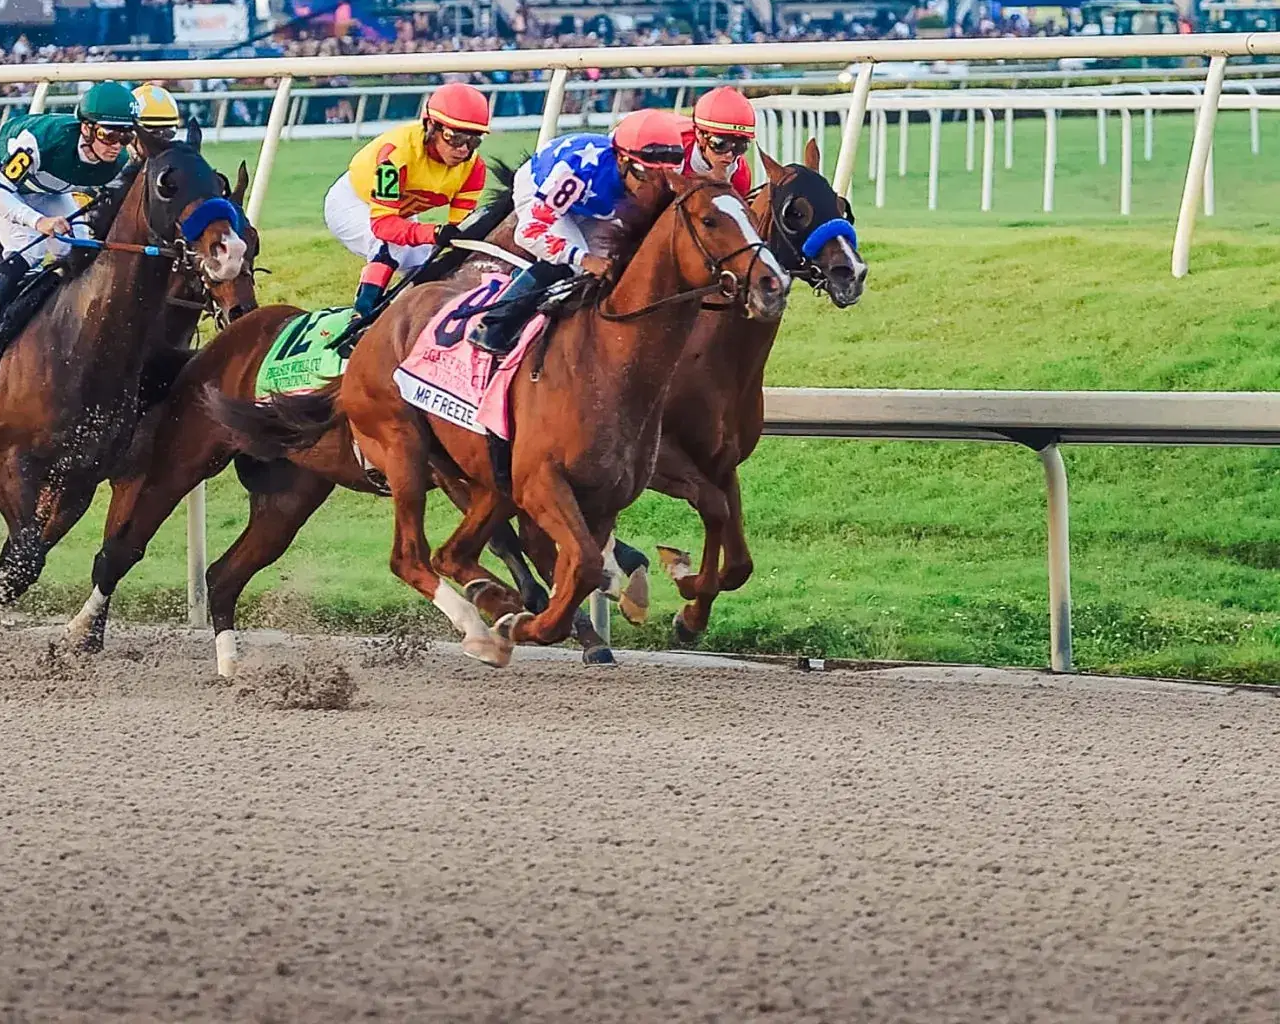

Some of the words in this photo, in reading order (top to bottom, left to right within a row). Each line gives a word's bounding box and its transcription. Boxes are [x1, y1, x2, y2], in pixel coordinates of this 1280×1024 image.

[5, 152, 30, 179] 6
[376, 167, 399, 198] 12
[553, 179, 577, 208] 8
[434, 279, 503, 348] 8
[413, 385, 430, 406] MR
[432, 393, 474, 426] FREEZE
